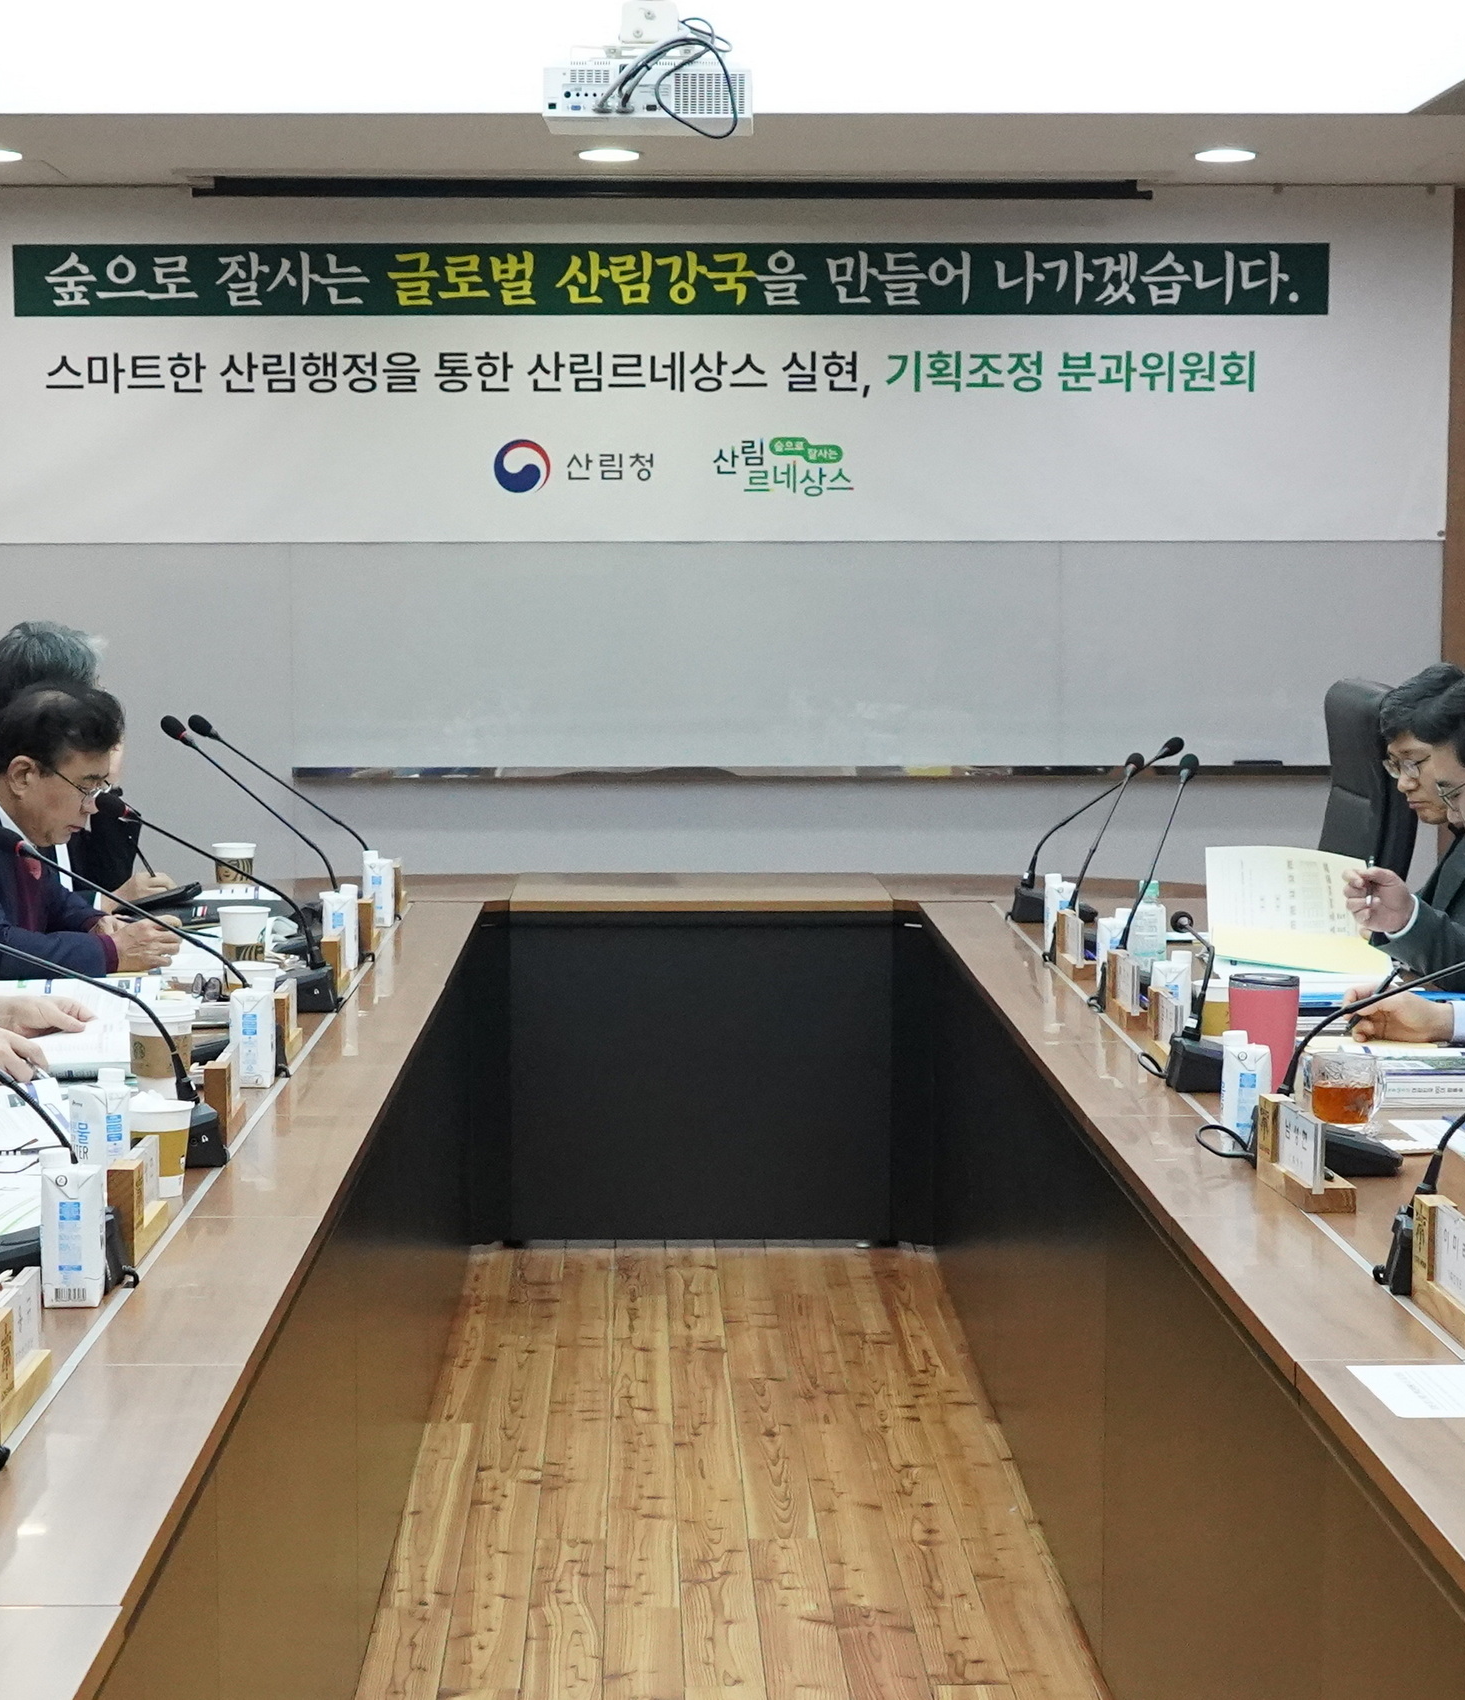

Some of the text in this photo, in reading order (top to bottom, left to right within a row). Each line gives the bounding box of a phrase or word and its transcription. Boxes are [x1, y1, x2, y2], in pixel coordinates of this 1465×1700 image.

[44, 250, 1300, 306] 숲으로 잘사는 글로벌 산림강국을 만들어 나가겠습니다.
[45, 350, 1256, 398] 스마트한 산림행정을 통한 산림르네상스 실현, 기획조정 분과위원회
[566, 452, 655, 482] 산림청
[713, 438, 764, 474] 산림
[743, 460, 854, 497] 르네상스
